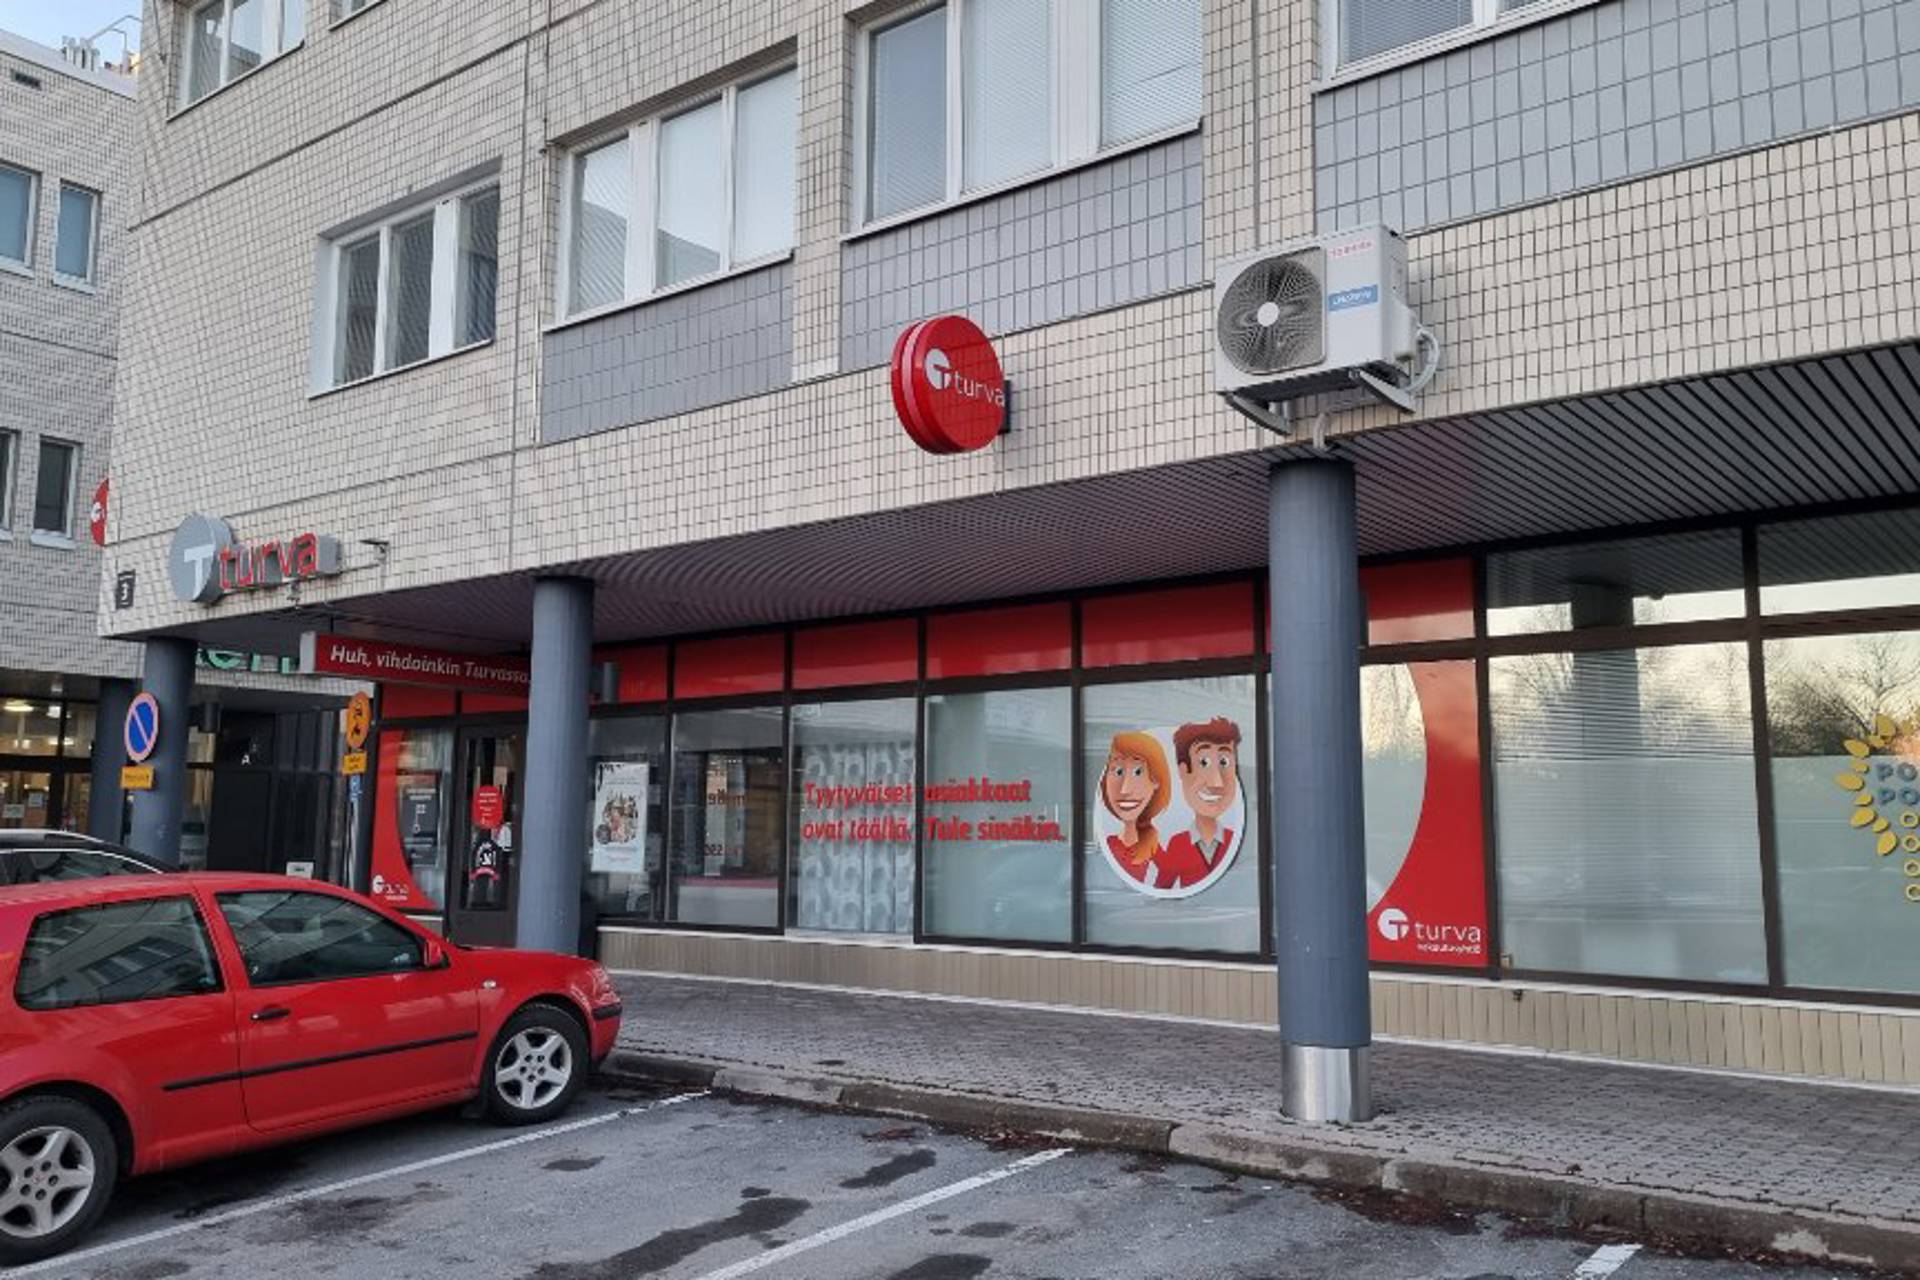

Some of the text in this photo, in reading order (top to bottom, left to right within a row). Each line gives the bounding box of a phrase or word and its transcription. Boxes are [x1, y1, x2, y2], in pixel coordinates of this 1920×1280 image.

[954, 371, 1005, 408] turva
[219, 532, 318, 591] turva
[330, 644, 372, 668] Huh,
[376, 650, 461, 677] vihdoinkin
[804, 780, 913, 810] Tyytyväiset
[803, 820, 844, 840] ovat
[924, 816, 973, 842] Tule
[1415, 922, 1481, 943] turva
